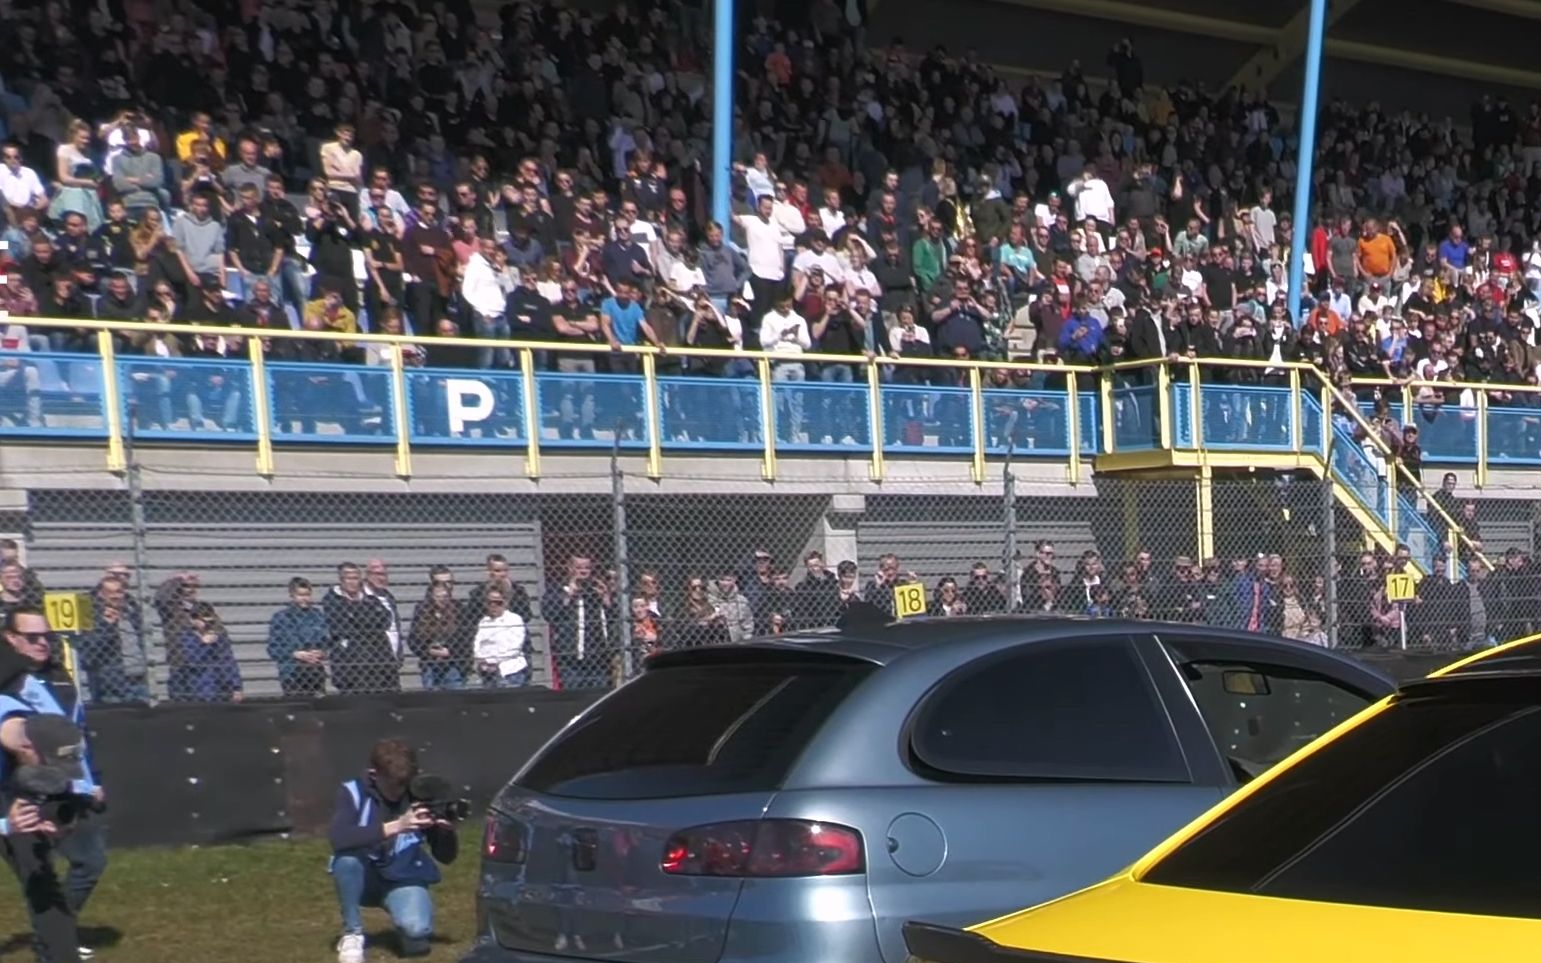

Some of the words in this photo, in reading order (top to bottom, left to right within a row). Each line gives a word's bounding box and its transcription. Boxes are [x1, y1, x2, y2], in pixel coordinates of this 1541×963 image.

[447, 379, 495, 432] P
[899, 588, 922, 613] 18
[1391, 577, 1409, 597] 17
[50, 599, 75, 629] 19
